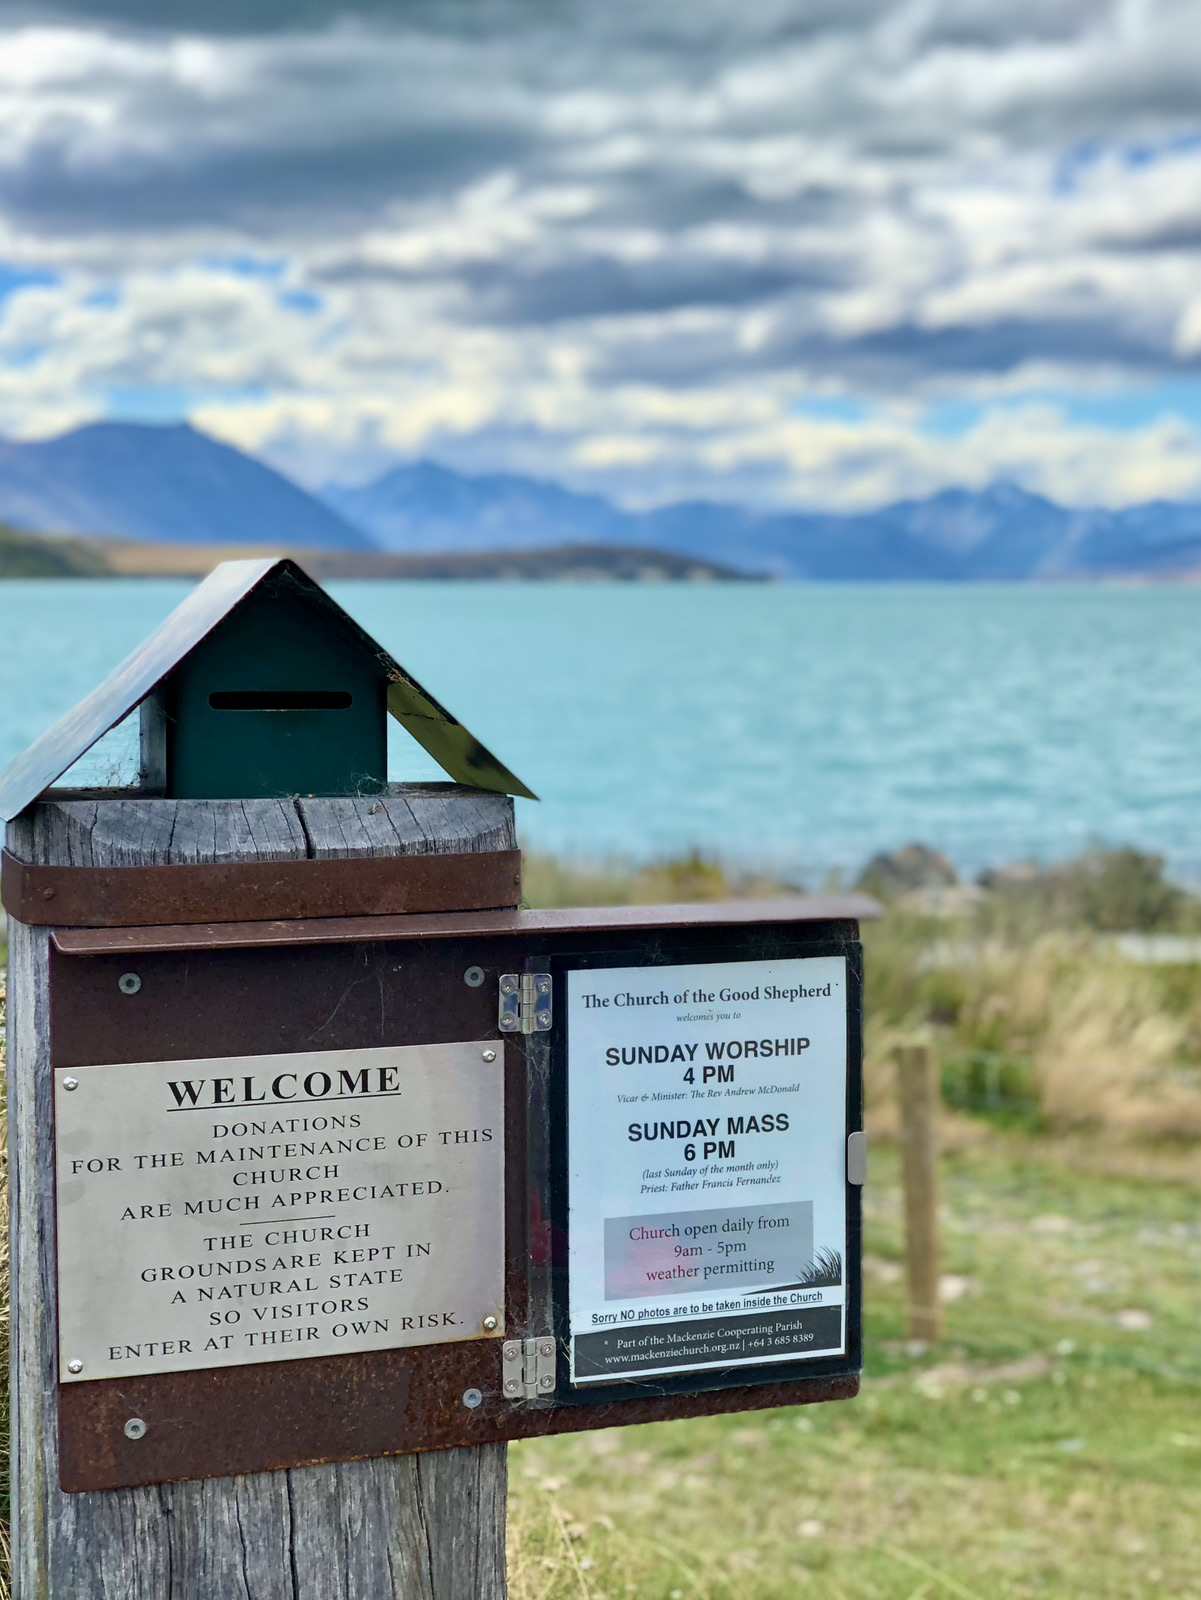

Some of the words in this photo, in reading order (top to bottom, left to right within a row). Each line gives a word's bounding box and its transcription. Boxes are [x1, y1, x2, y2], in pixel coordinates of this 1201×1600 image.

[582, 994, 609, 1008] The
[614, 992, 669, 1006] Church
[674, 990, 690, 1004] of
[692, 990, 715, 1002] the
[719, 987, 760, 1002] Good
[764, 984, 831, 1002] Shepherd
[676, 1012, 714, 1022] welcomes
[716, 1012, 730, 1022] you
[733, 1012, 741, 1020] to
[606, 1044, 698, 1066] SUNDAY
[705, 1038, 810, 1060] WORSHIP
[683, 1068, 695, 1084] 4
[703, 1065, 734, 1084] PM
[167, 1067, 401, 1108] WELCOME
[617, 1094, 639, 1103] Vicar
[641, 1092, 649, 1102] &
[651, 1091, 688, 1101] Minister:
[690, 1090, 705, 1099] The
[708, 1088, 722, 1098] Rev
[724, 1086, 756, 1097] Andrew
[758, 1084, 800, 1094] McDonald
[212, 1114, 361, 1139] DONATIONS
[628, 1118, 720, 1142] SUNDAY
[727, 1114, 790, 1134] MASS
[71, 1157, 122, 1174] FOR
[134, 1152, 184, 1169] THE
[196, 1136, 386, 1165] MAINTENANCE
[397, 1133, 427, 1148] OF
[438, 1128, 494, 1145] THIS
[684, 1144, 696, 1161] 6
[703, 1140, 735, 1160] PM
[232, 1165, 339, 1186] CHURCH
[642, 1169, 662, 1180] (last
[664, 1167, 697, 1178] Sunday
[698, 1165, 709, 1177] of
[710, 1164, 724, 1174] the
[726, 1162, 754, 1172] month
[757, 1160, 779, 1171] only)
[640, 1183, 668, 1194] Priest:
[671, 1181, 699, 1192] Father
[702, 1178, 734, 1189] Francis
[736, 1174, 781, 1186] Fernandez
[120, 1203, 171, 1220] ARE
[184, 1196, 259, 1216] MUCH
[271, 1180, 450, 1208] APPRECIATED.
[204, 1234, 253, 1252] THE
[265, 1223, 370, 1246] CHURCH
[629, 1225, 680, 1241] Church
[684, 1223, 717, 1238] open
[721, 1218, 754, 1236] daily
[758, 1216, 790, 1230] from
[333, 1246, 396, 1265] KEPT
[406, 1242, 432, 1258] IN
[674, 1244, 703, 1257] 9am
[717, 1240, 747, 1256] 5pm
[646, 1265, 700, 1281] weather
[703, 1259, 774, 1280] permitting
[170, 1290, 186, 1304] A
[198, 1275, 318, 1302] NATURAL
[329, 1269, 403, 1289] STATE
[210, 1310, 241, 1326] SO
[252, 1297, 369, 1321] VISITORS
[591, 1312, 618, 1324] Sorry
[620, 1310, 635, 1320] NO
[638, 1307, 670, 1320] photos
[673, 1307, 688, 1315] are
[690, 1304, 699, 1313] to
[702, 1303, 714, 1312] be
[716, 1299, 741, 1310] taken
[743, 1296, 771, 1308] inside
[773, 1295, 788, 1305] the
[790, 1291, 822, 1303] Church
[109, 1340, 193, 1361] ENTER
[204, 1335, 234, 1351] AT
[245, 1326, 320, 1348] THEIR
[332, 1319, 390, 1338] OWN
[401, 1312, 464, 1330] RISK.
[617, 1338, 635, 1349] Part
[638, 1336, 650, 1347] of
[650, 1334, 664, 1345] the
[667, 1330, 715, 1344] Mackenzie
[717, 1324, 773, 1340] Cooperating
[776, 1321, 803, 1332] Parish
[604, 1341, 740, 1364] www.mackenziechurch.org.nz
[747, 1338, 764, 1348] +64
[767, 1337, 772, 1346] 3
[774, 1336, 790, 1345] 685
[792, 1333, 814, 1343] 8389
